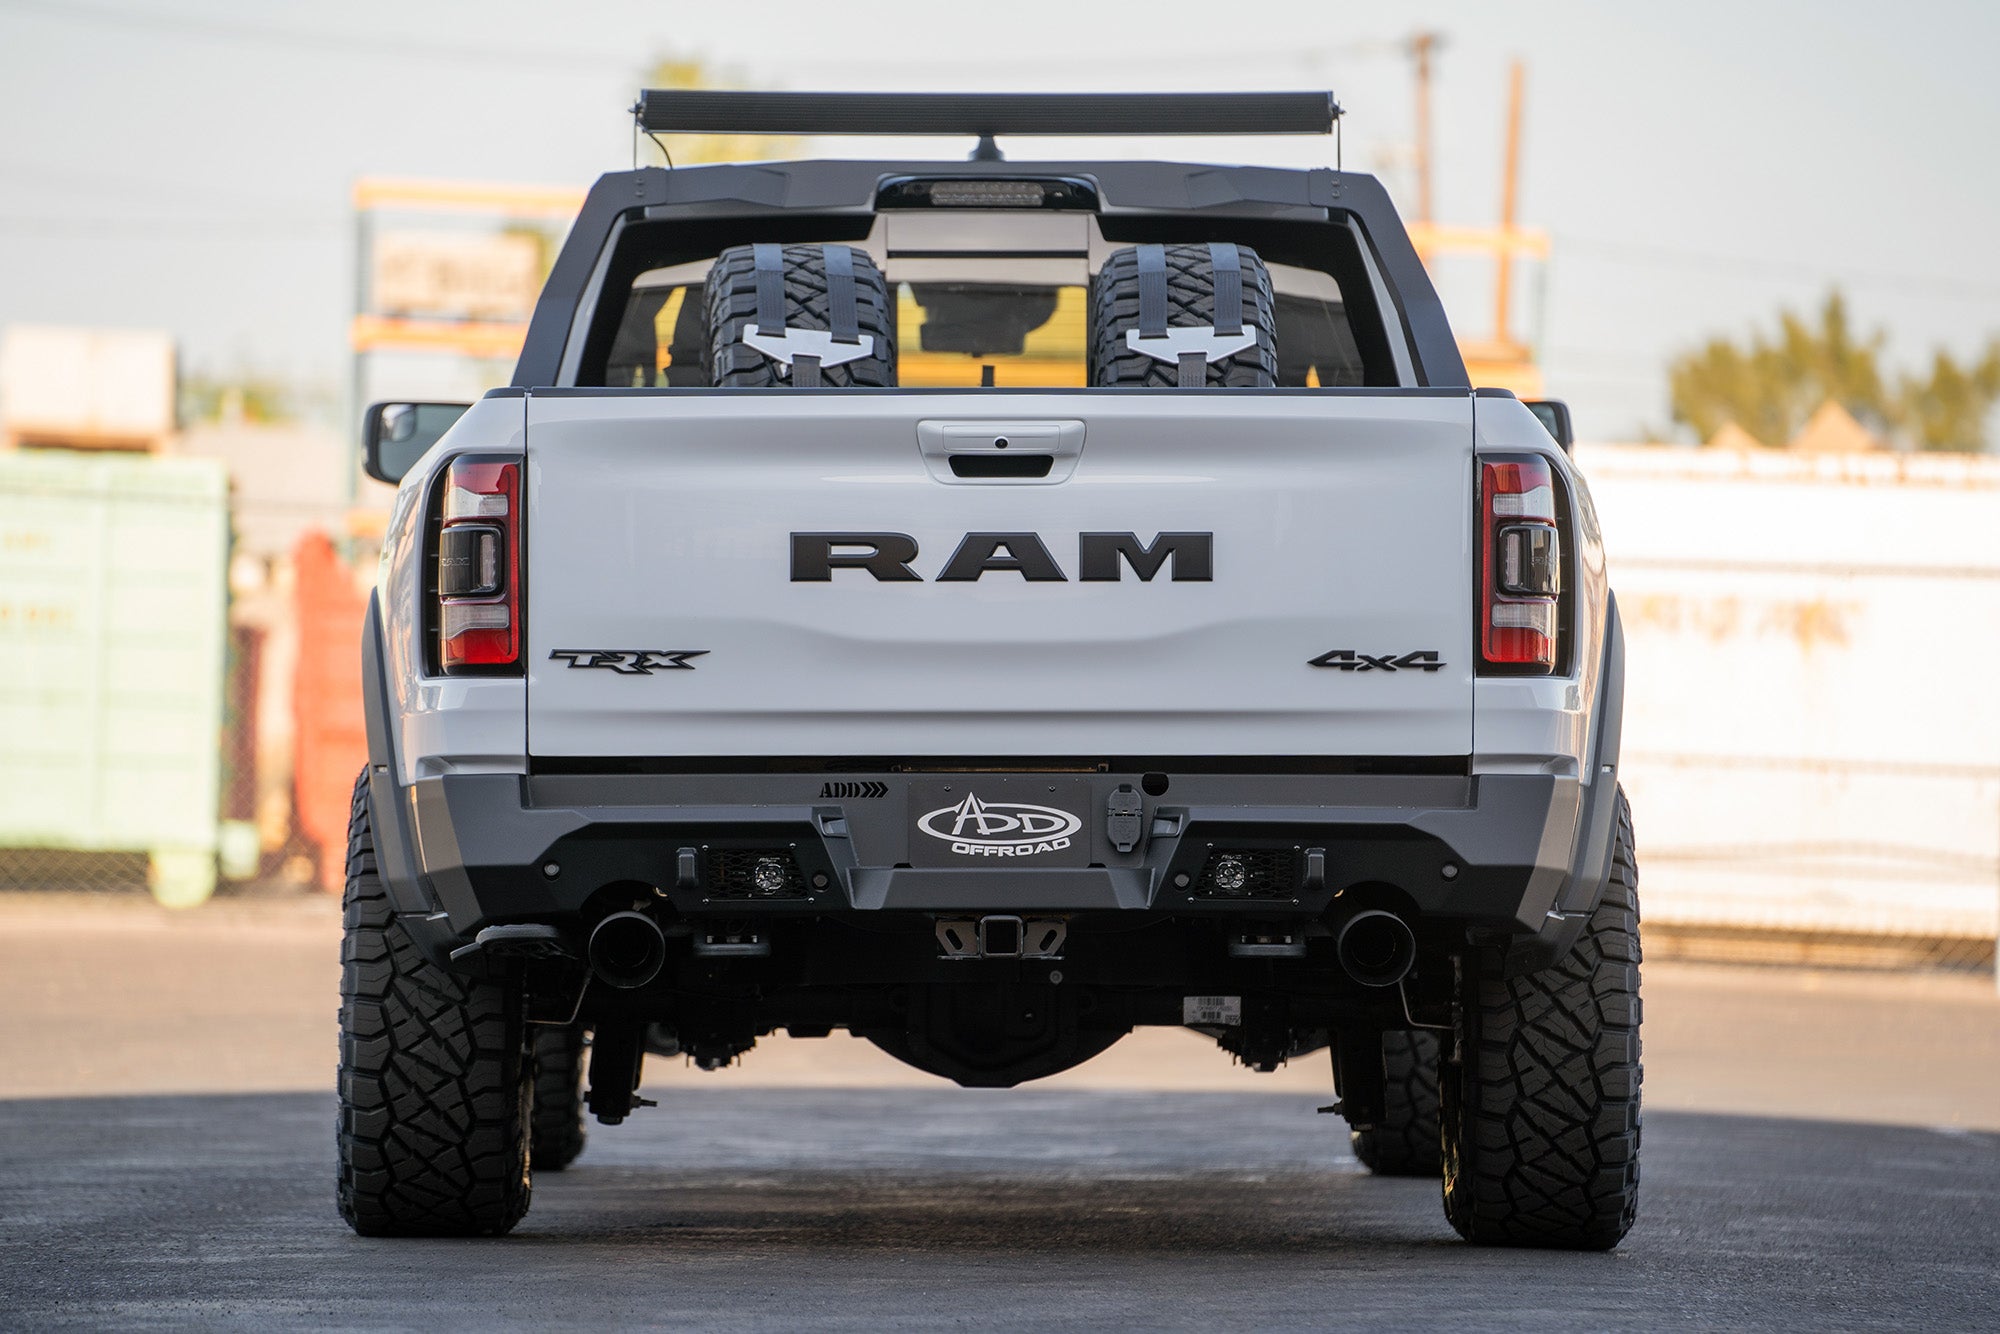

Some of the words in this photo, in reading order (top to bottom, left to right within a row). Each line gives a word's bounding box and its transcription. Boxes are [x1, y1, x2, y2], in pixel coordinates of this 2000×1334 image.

[790, 532, 1213, 582] RAM
[549, 649, 711, 675] TRX
[1307, 650, 1447, 671] 4x4
[819, 782, 861, 798] ADD
[951, 791, 1066, 835] ADD
[951, 837, 1071, 857] OFFROAD
